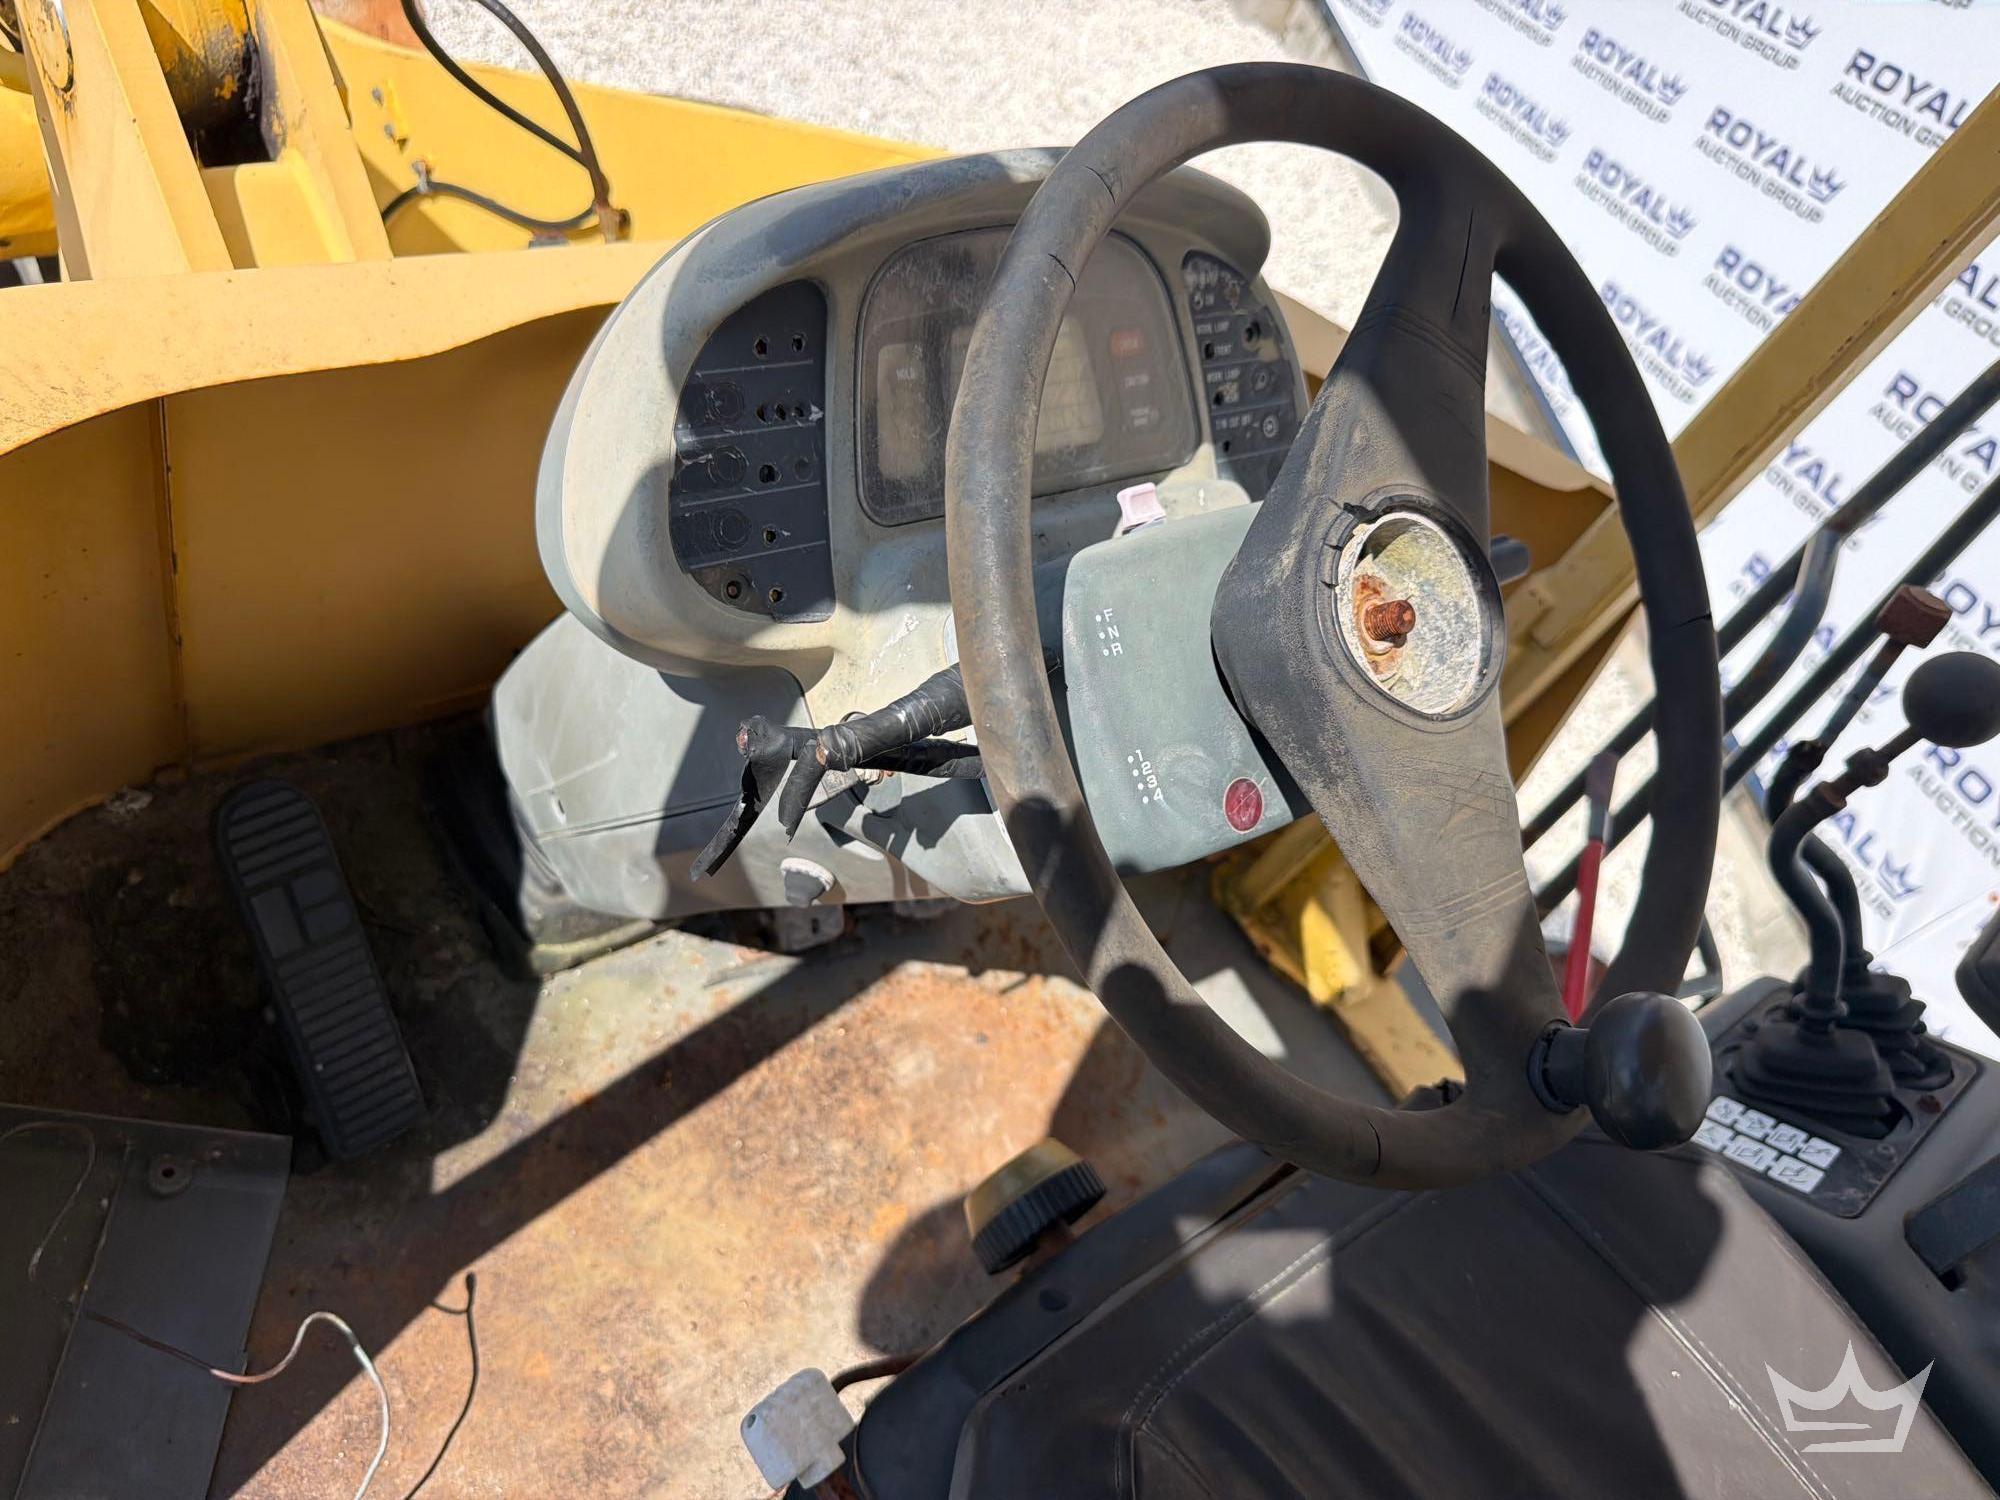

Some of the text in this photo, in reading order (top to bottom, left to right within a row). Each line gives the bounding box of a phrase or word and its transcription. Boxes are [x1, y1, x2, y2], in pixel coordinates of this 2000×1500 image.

[1578, 27, 1658, 96] ROYAL
[1740, 32, 1801, 70] GROUP
[1482, 72, 1547, 136] ROYAL
[1844, 48, 1968, 130] ROYAL
[1829, 81, 1916, 138] AUCTION
[1704, 105, 1807, 190] ROYAL
[1583, 148, 1668, 225] ROYAL
[1693, 135, 1825, 224] AUCTION GROUP
[1103, 608, 1114, 622] F
[1107, 625, 1120, 639] N
[1111, 642, 1123, 656] R
[1135, 749, 1144, 762] 1
[1141, 761, 1152, 775] 2
[1146, 775, 1158, 788] 3
[1153, 787, 1164, 801] 4
